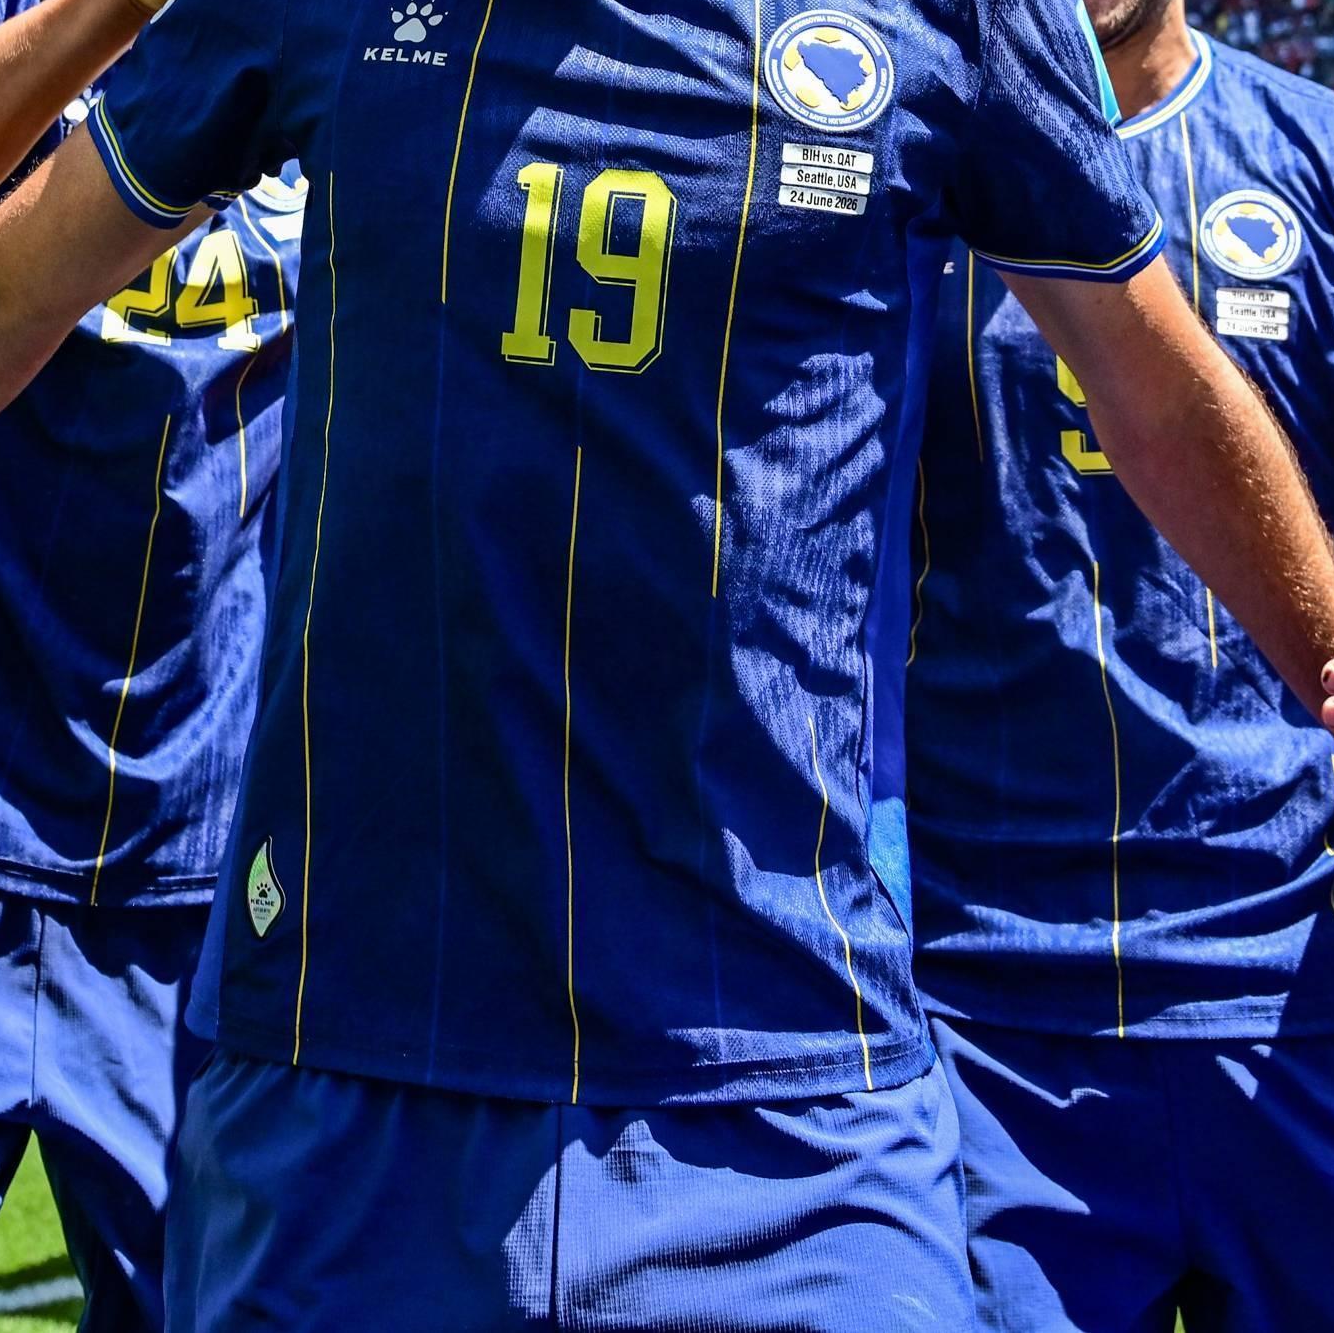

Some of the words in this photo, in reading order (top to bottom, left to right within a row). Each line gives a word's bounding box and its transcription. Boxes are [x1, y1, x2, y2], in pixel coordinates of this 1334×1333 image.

[363, 47, 448, 67] KELME
[802, 148, 820, 162] BIH
[822, 153, 836, 164] vs.
[837, 152, 857, 167] QAT
[797, 169, 836, 188] Seattle,
[837, 174, 857, 189] USA
[790, 190, 804, 204] 24
[807, 192, 833, 207] June
[835, 196, 858, 211] 2026
[501, 162, 678, 375] 19
[101, 228, 262, 353] 24
